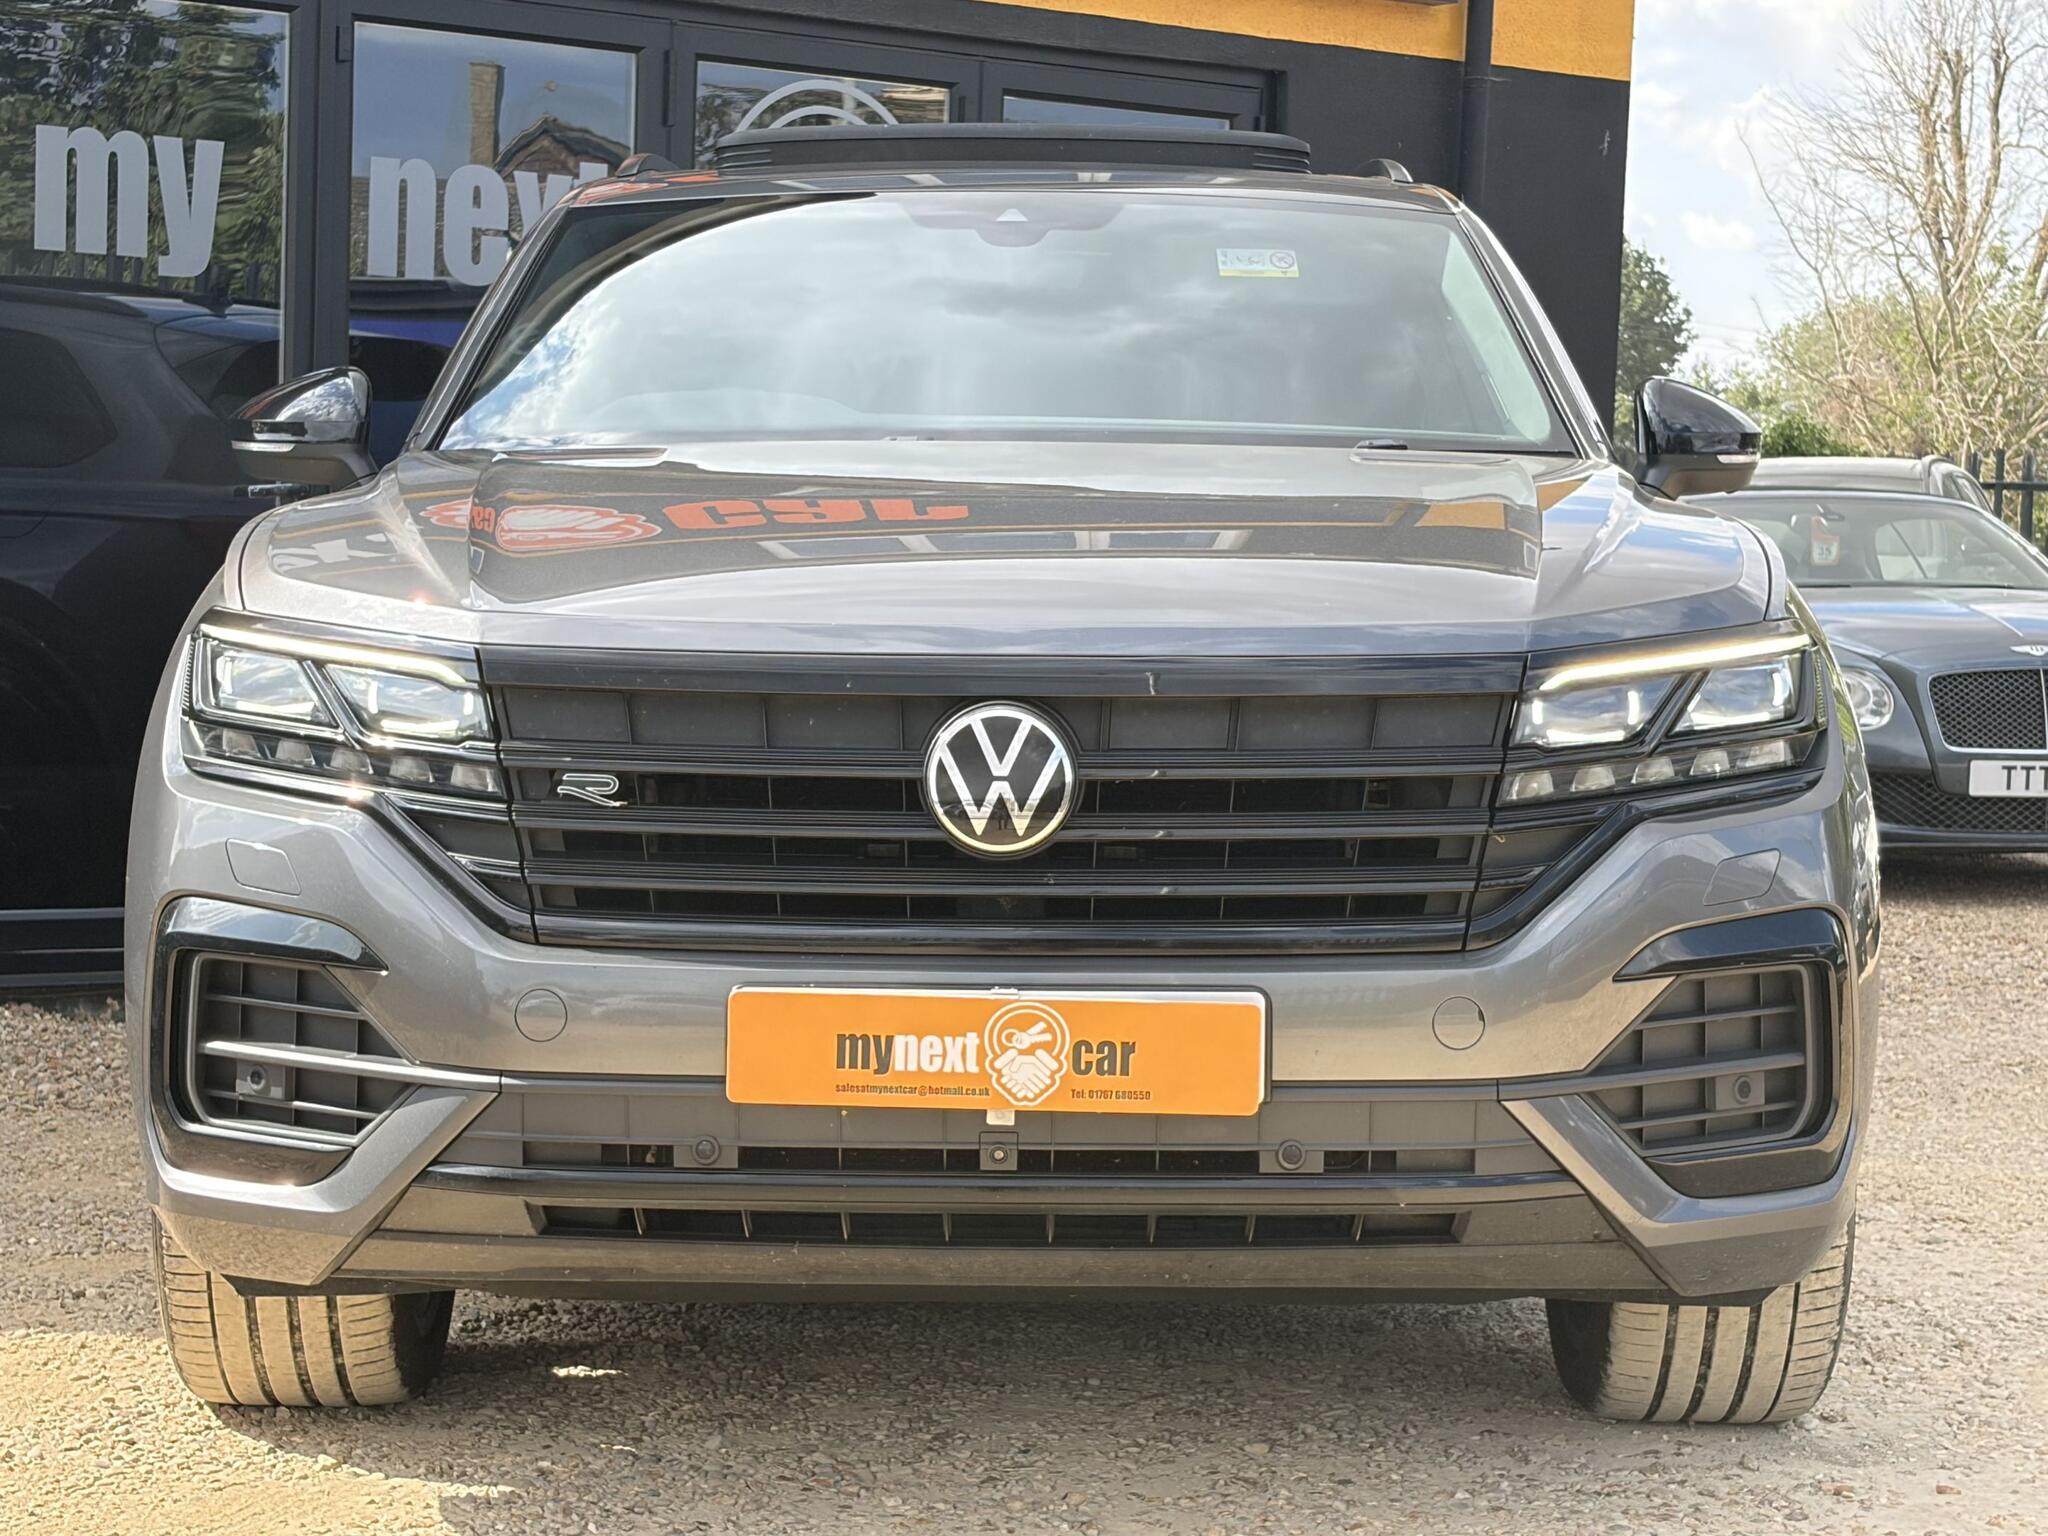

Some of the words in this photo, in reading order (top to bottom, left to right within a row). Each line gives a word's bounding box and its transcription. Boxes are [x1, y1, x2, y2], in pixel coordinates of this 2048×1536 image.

[34, 124, 224, 278] my
[367, 156, 608, 286] ne
[557, 773, 619, 807] R
[2001, 765, 2048, 791] TTT
[836, 1033, 980, 1076] mynext
[1071, 1039, 1136, 1077] car
[1071, 1088, 1086, 1099] Tel:
[1088, 1089, 1113, 1100] 01767
